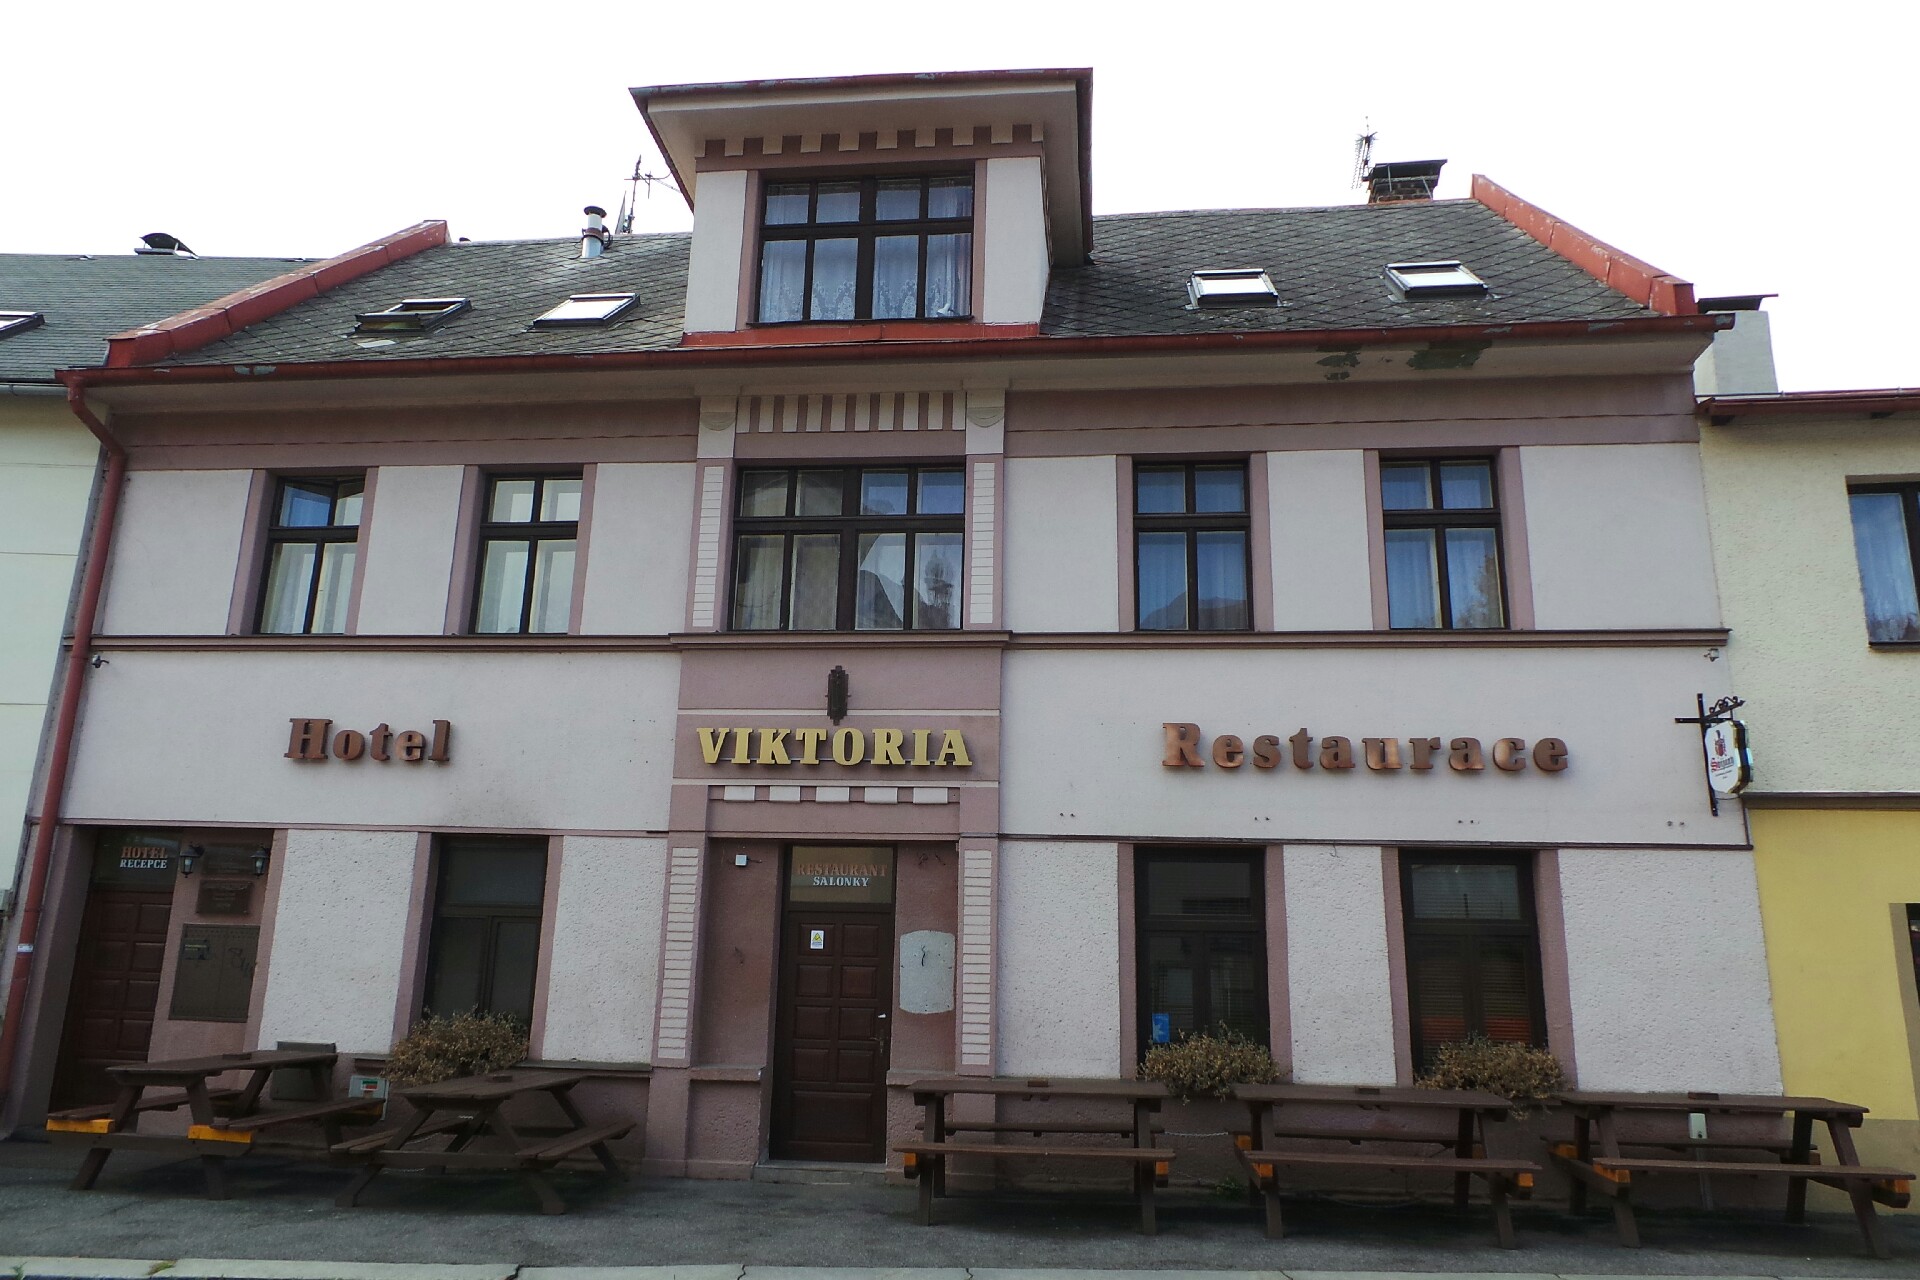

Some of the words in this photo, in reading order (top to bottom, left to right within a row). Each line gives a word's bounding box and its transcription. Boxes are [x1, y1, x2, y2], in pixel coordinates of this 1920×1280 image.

[284, 718, 451, 761] Hotel
[1162, 722, 1569, 771] Restaurace
[696, 727, 973, 767] VIKTORIA
[121, 846, 168, 859] HOTEL
[119, 859, 168, 869] RECEPCE
[797, 863, 888, 877] RESTAURANT
[812, 876, 870, 887] SALONKY
